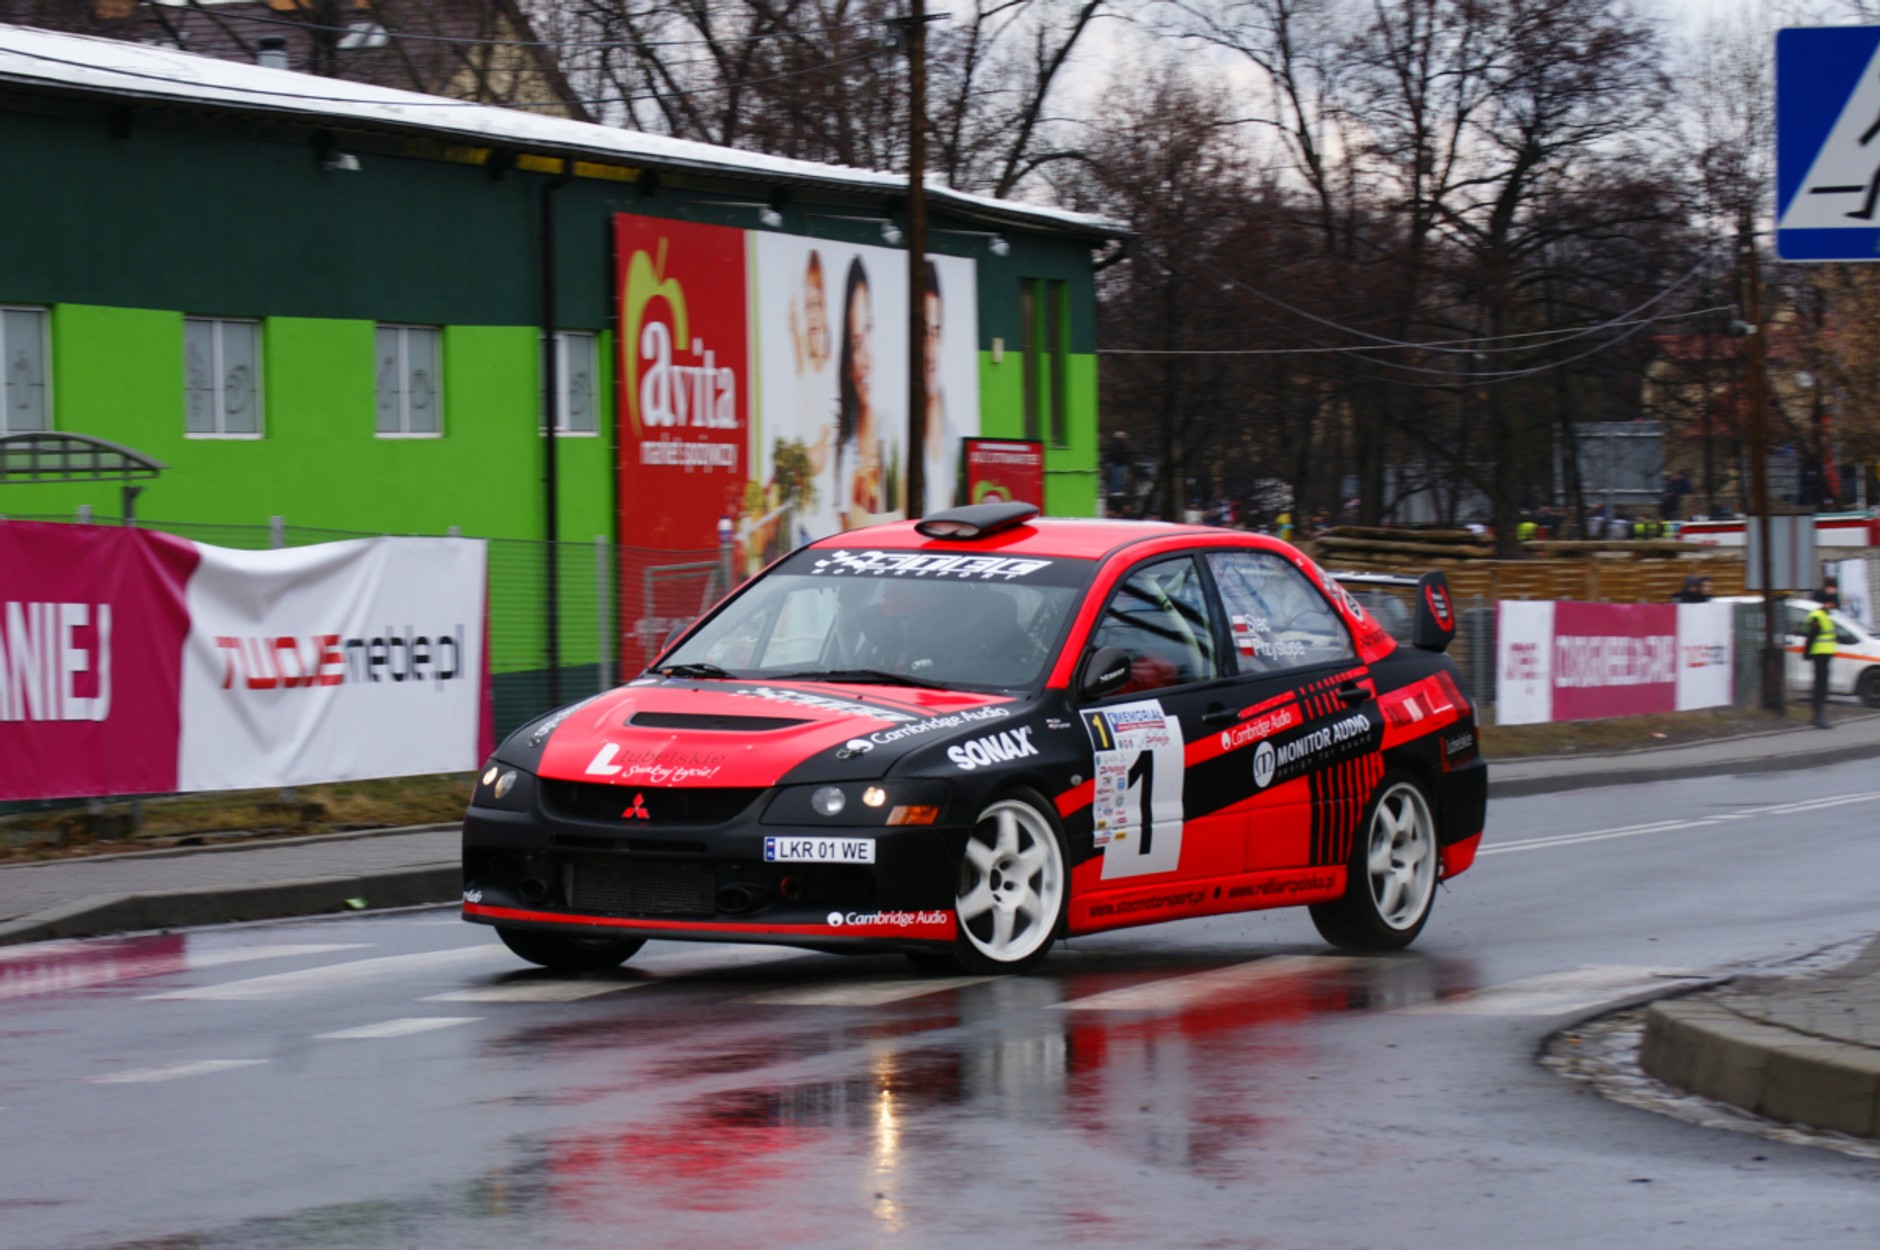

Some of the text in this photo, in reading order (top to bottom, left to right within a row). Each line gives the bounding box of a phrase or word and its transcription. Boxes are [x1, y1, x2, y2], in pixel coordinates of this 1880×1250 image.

[640, 321, 738, 428] avita
[870, 705, 1010, 745] Cambridge Audio
[1091, 714, 1110, 748] 1
[1231, 709, 1292, 747] Cambridge Audio
[1277, 713, 1371, 767] MONITOR AUDIO
[1127, 749, 1154, 855] 1
[780, 841, 868, 860] LKR 01 WE
[846, 910, 948, 927] Cambridge Audio
